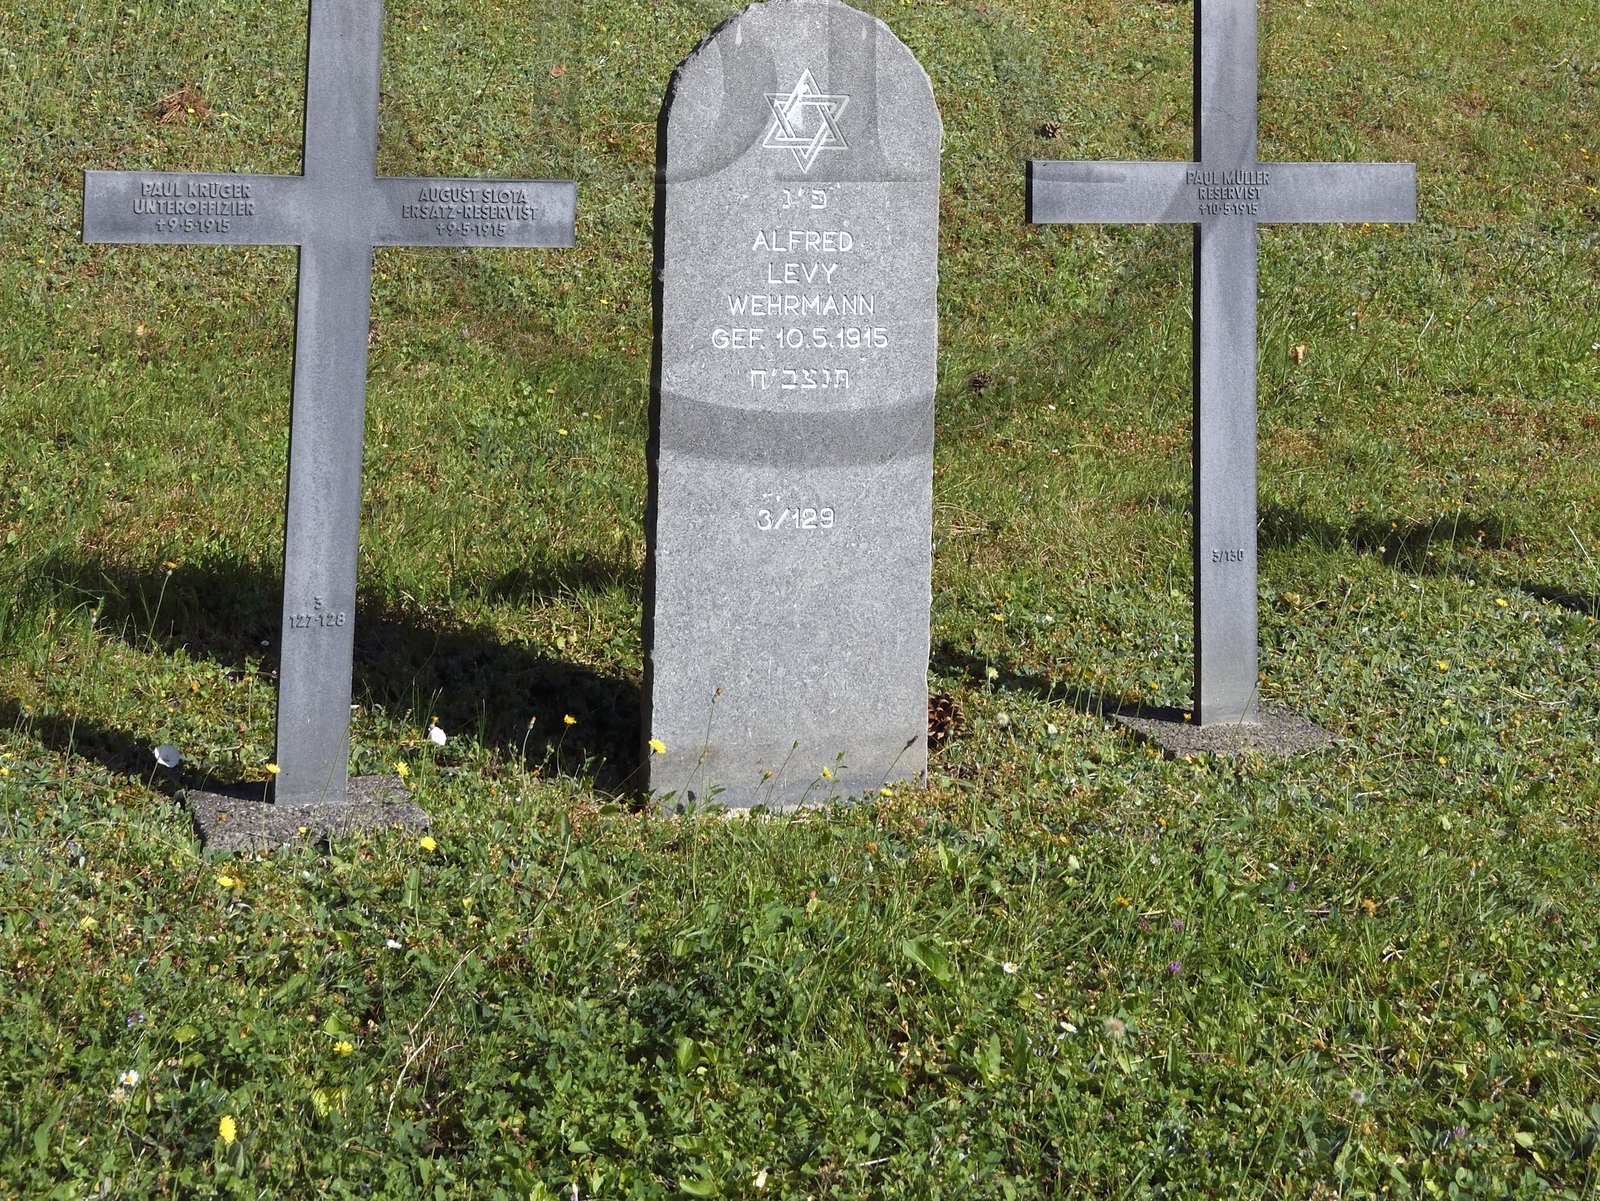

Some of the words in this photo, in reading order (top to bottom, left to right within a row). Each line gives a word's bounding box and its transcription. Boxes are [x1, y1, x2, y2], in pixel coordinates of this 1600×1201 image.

[1186, 170, 1219, 186] PAUL
[1222, 169, 1271, 186] MÜLLER
[141, 182, 182, 198] PAUL
[187, 182, 252, 199] KRÜGER
[418, 187, 479, 203] AUGUST
[482, 189, 528, 204] SLOTA
[1198, 186, 1261, 200] RESERVIST
[132, 199, 255, 216] UNTEROFFIZIER
[402, 204, 538, 220] ERSATZ-RESERVIST
[752, 230, 853, 252] ALFRED
[767, 262, 838, 284] LEVY
[728, 294, 876, 316] WEHRMANN
[776, 327, 890, 349] 10.5.1915
[756, 507, 836, 531] 3/129
[289, 611, 346, 628] 127-128
